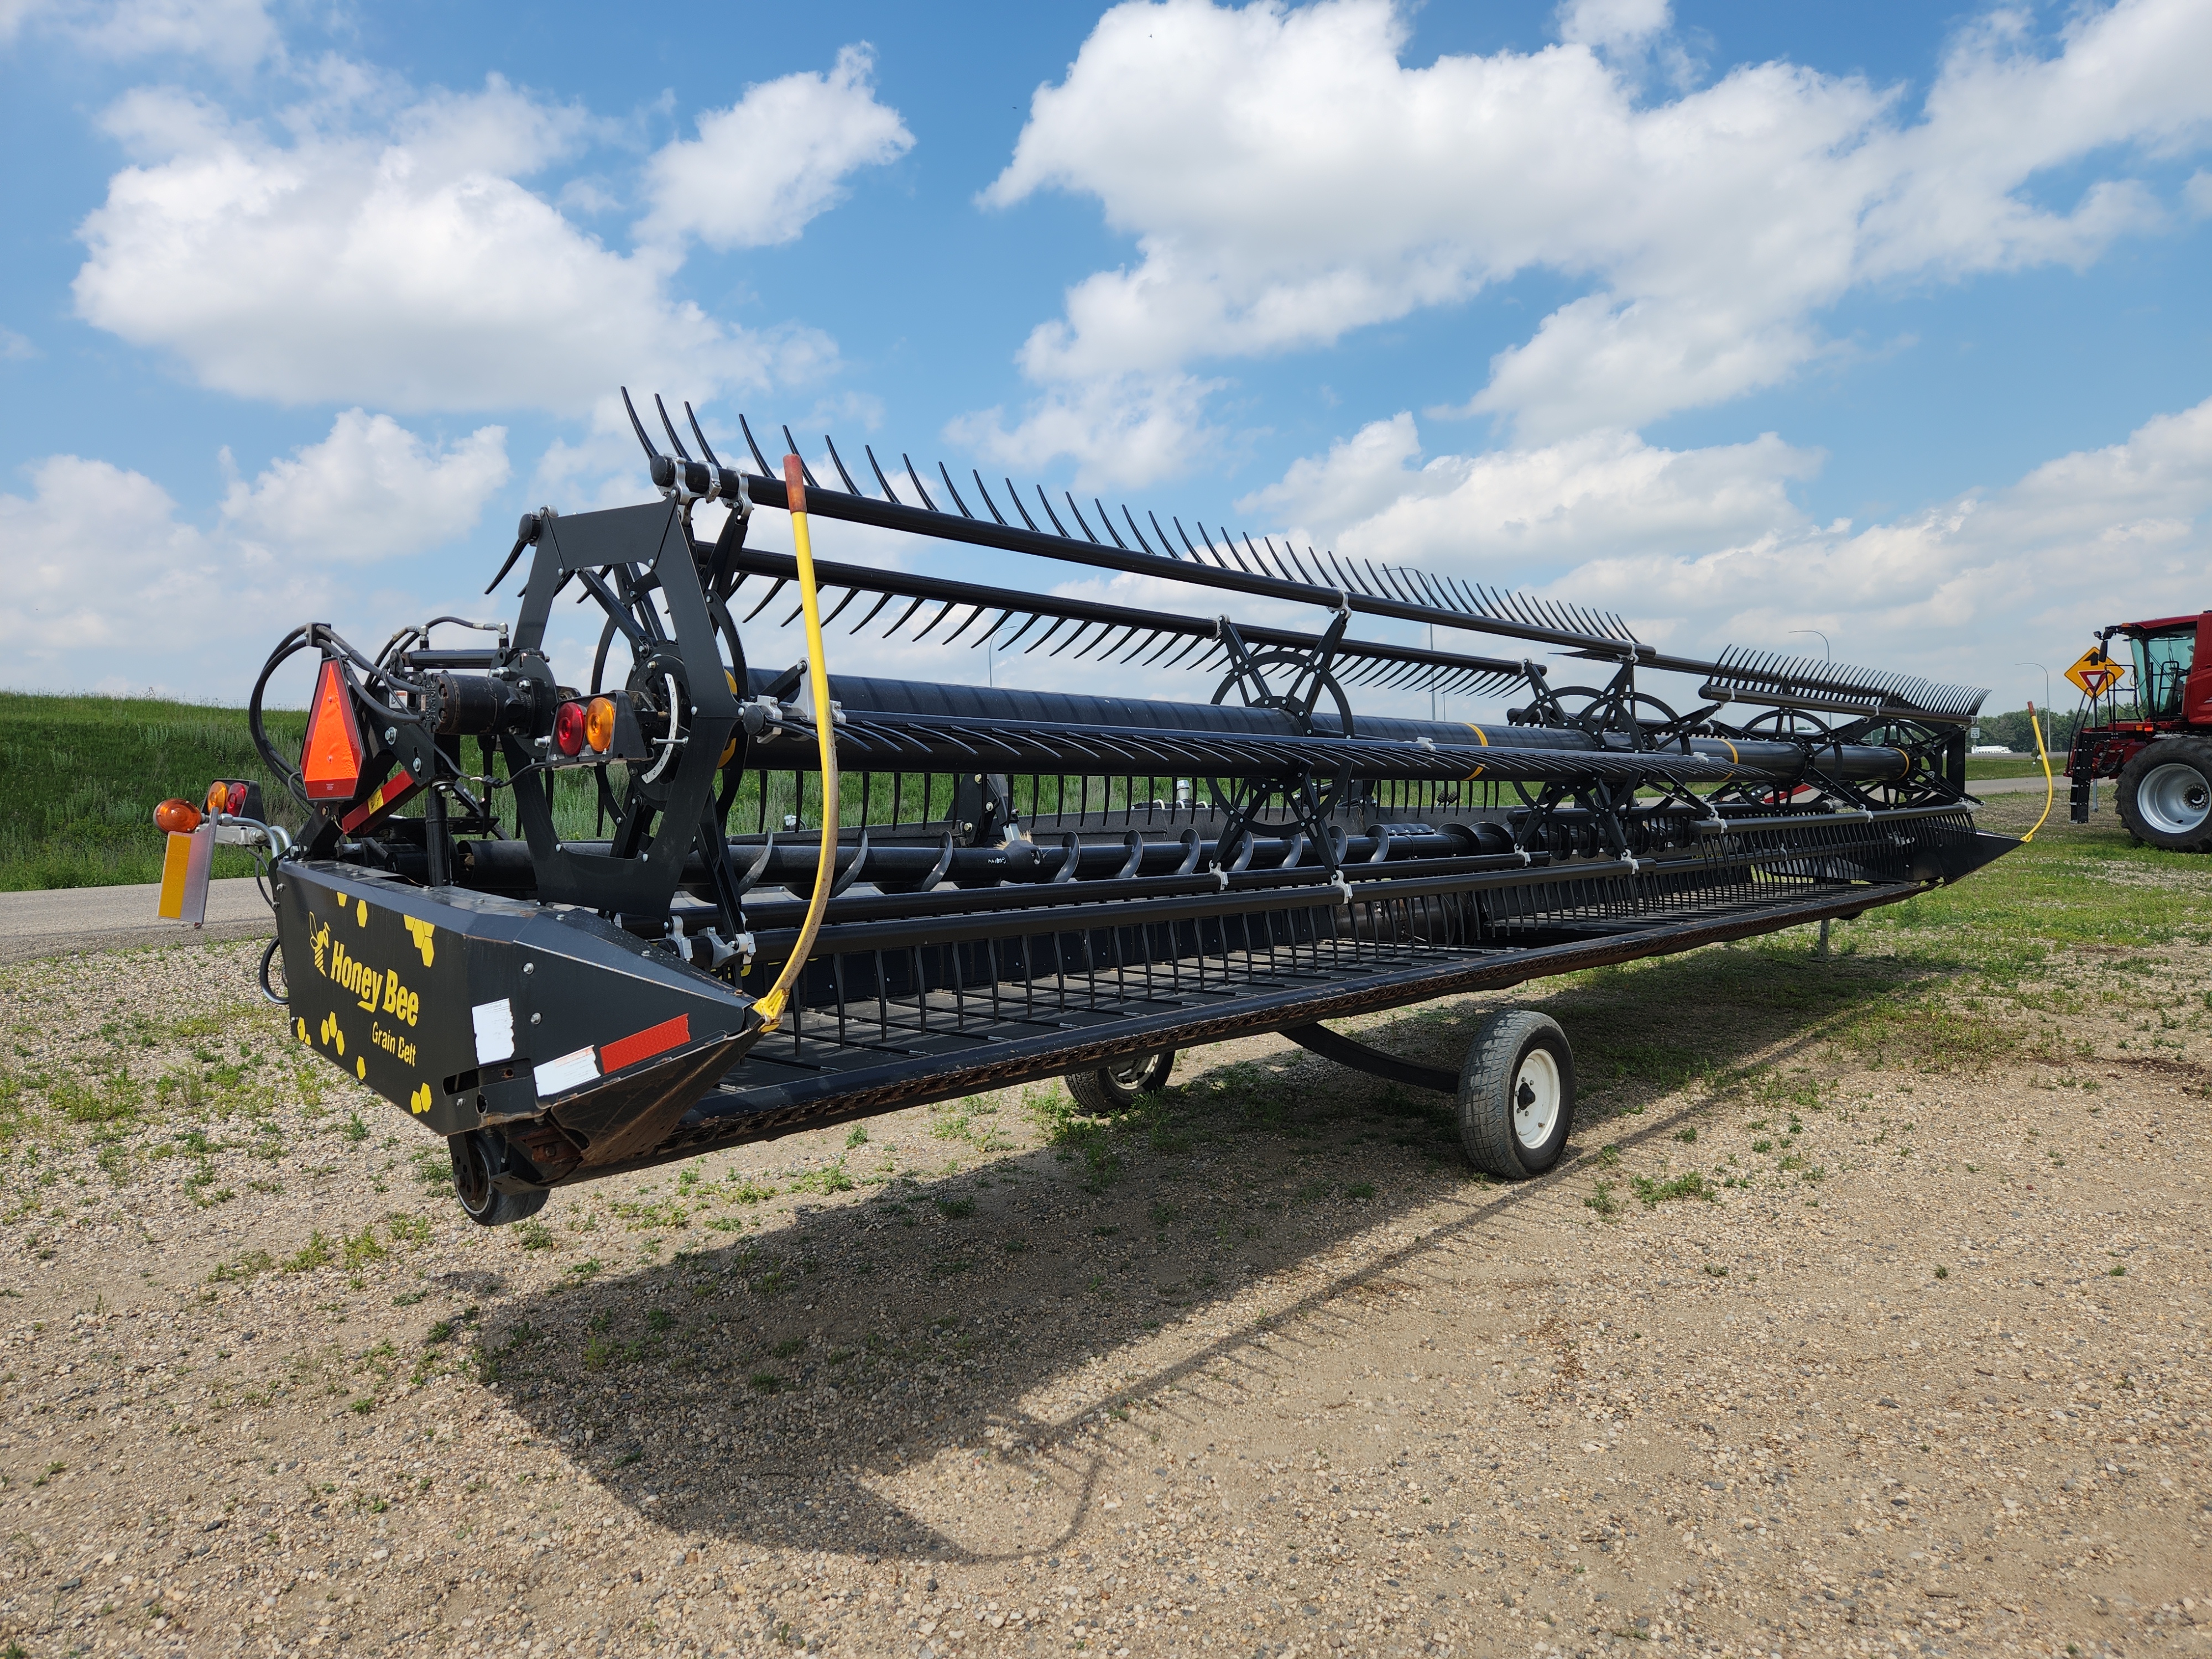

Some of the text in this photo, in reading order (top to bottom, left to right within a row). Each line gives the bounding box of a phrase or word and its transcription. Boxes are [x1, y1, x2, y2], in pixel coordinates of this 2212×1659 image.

[330, 940, 383, 1013] Honey
[382, 968, 419, 1026] Bee
[372, 1021, 416, 1067] Grain Belt
